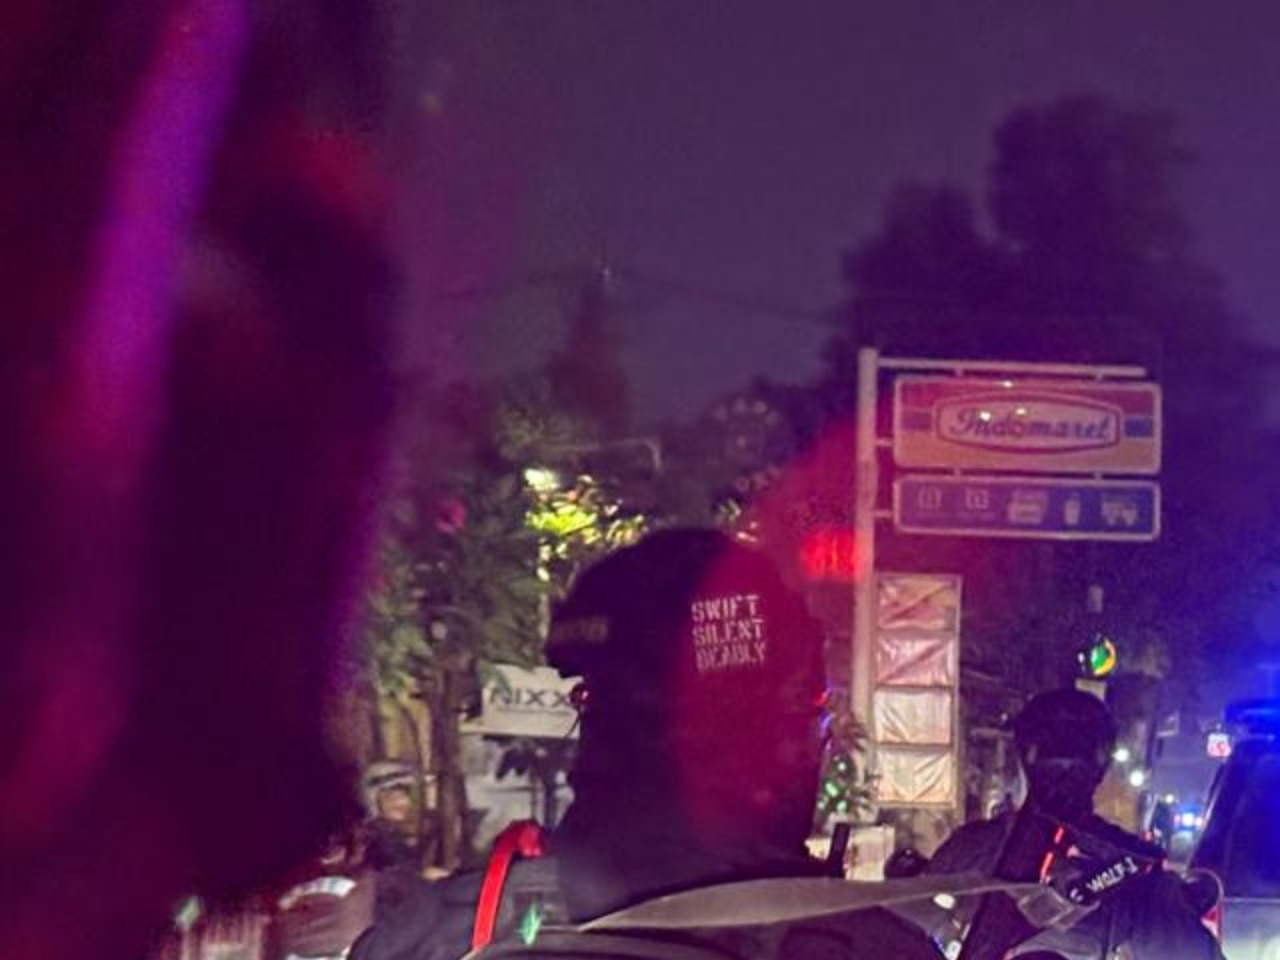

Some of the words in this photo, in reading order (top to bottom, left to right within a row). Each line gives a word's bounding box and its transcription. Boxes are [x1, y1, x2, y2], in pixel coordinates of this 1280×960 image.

[949, 405, 1110, 441] Indomaret
[691, 595, 760, 623] SWIFT
[692, 618, 764, 646] SILENT
[696, 642, 767, 673] DEADLY
